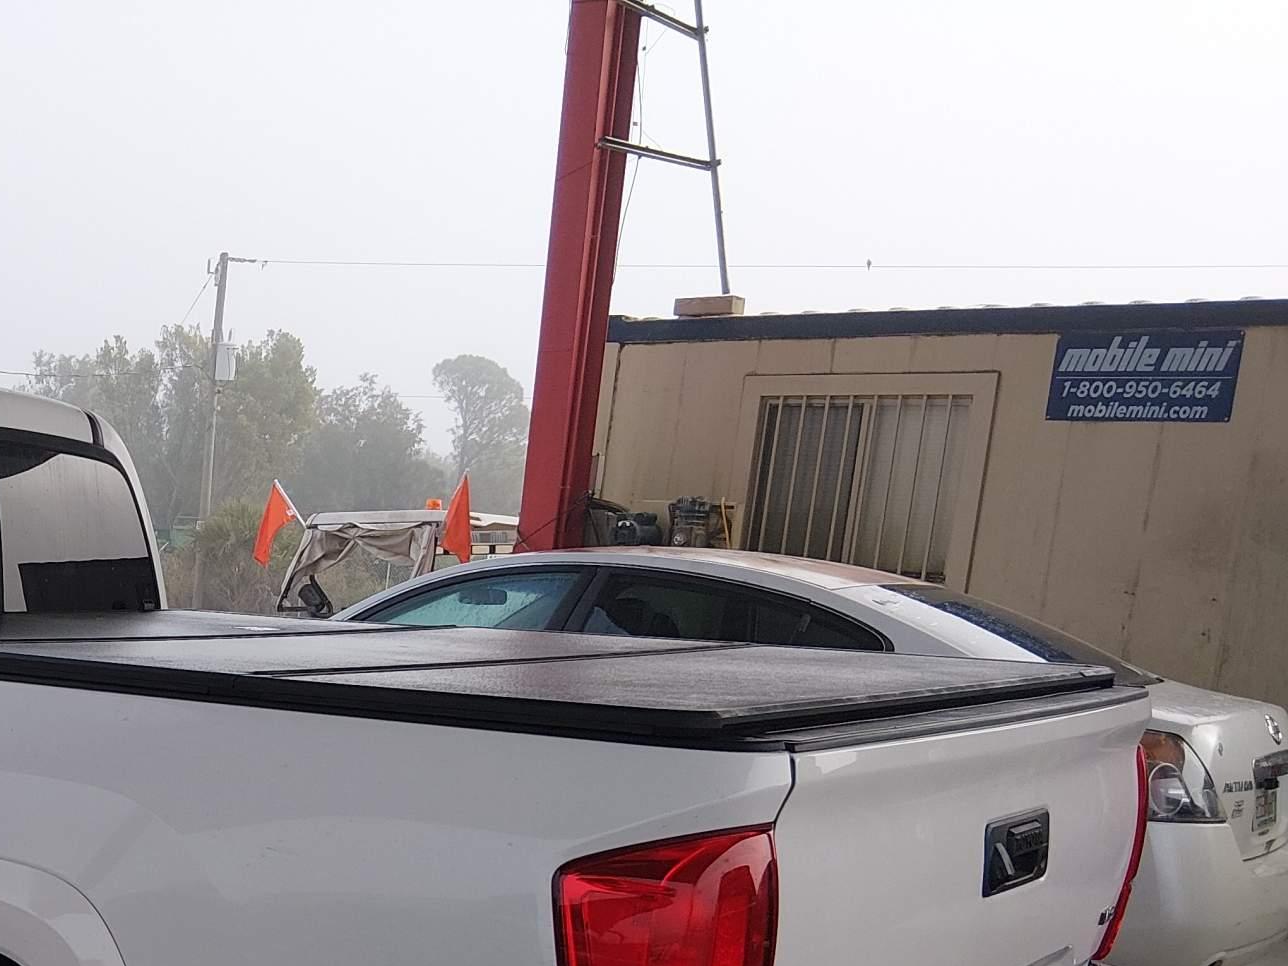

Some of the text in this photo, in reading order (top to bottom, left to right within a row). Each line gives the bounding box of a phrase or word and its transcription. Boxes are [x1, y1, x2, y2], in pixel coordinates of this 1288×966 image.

[1058, 336, 1236, 372] mobile mini
[1062, 381, 1221, 398] 1-800-950-6464
[1067, 402, 1208, 419] mobilemini.com
